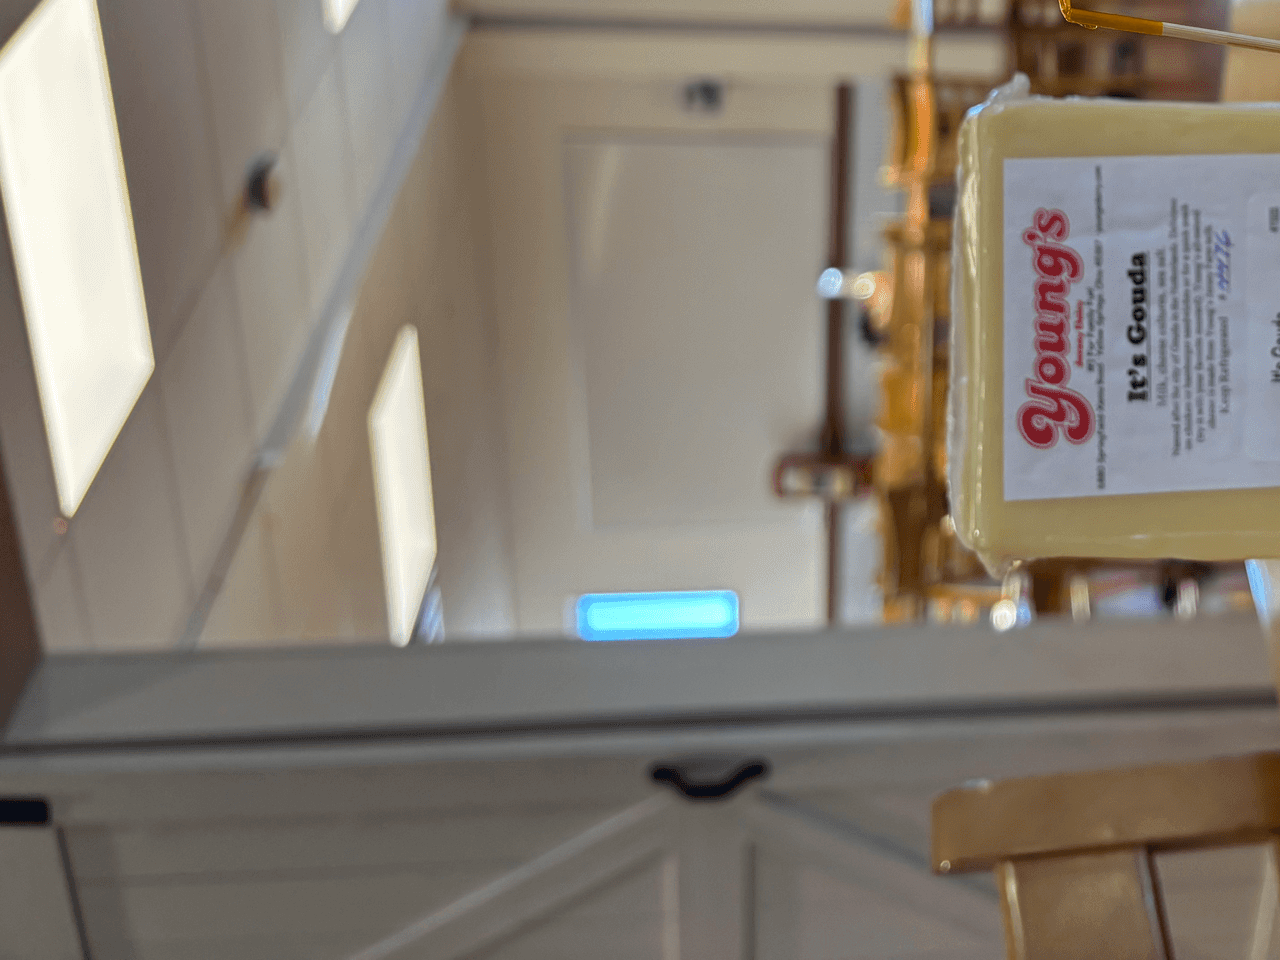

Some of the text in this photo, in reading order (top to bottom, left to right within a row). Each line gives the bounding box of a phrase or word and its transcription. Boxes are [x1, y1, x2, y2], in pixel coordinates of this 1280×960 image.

[1016, 208, 1095, 450] Young's
[1126, 252, 1148, 402] It's Gouda
